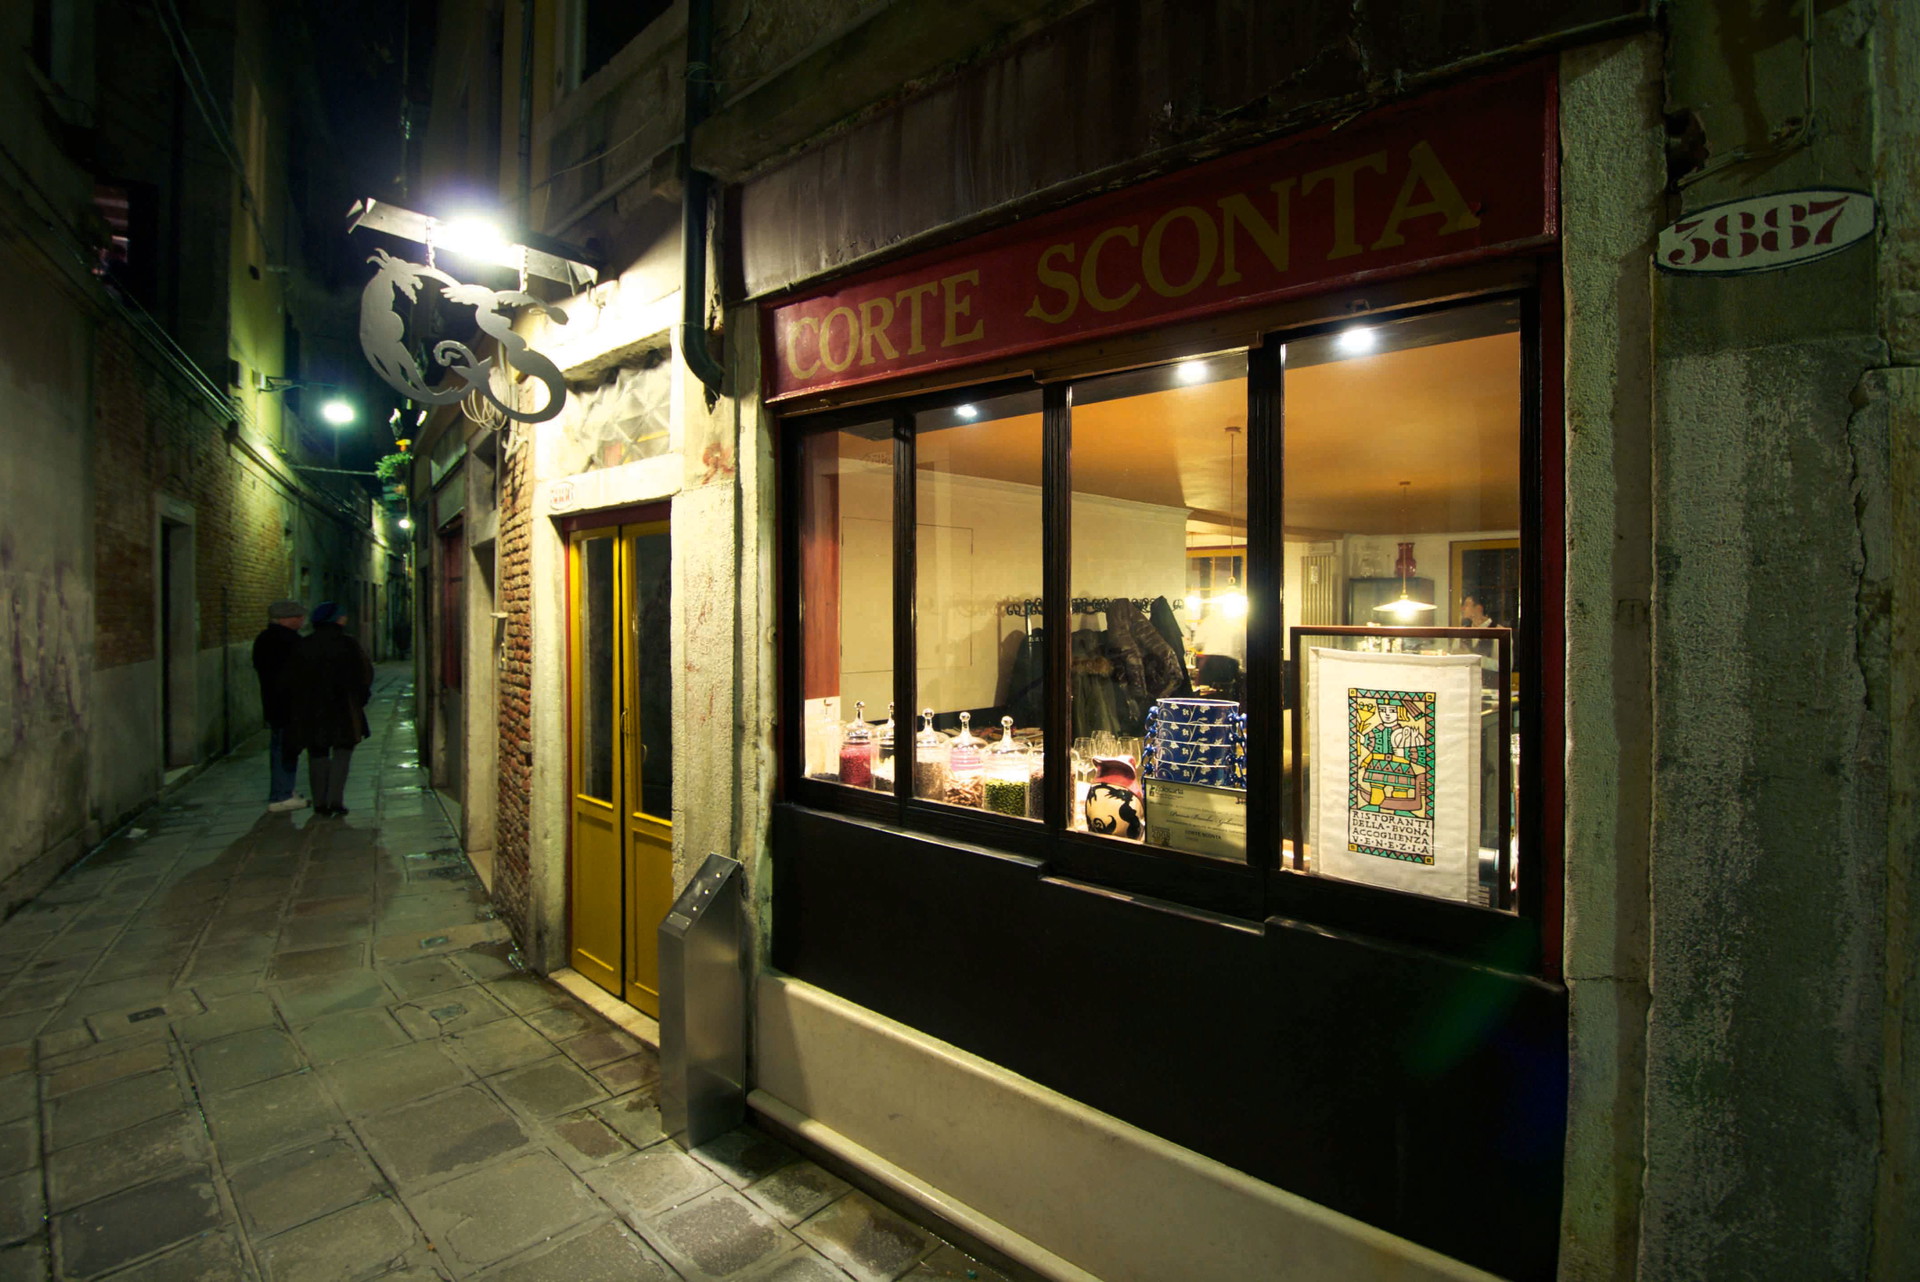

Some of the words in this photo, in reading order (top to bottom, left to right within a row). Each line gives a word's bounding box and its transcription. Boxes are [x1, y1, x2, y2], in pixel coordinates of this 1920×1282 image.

[1667, 195, 1850, 266] 3887
[785, 268, 986, 382] CORTE
[1025, 139, 1481, 325] SCONTA
[1352, 810, 1430, 828] RISTORANTI
[1352, 827, 1430, 845] ACCOGLIENZA
